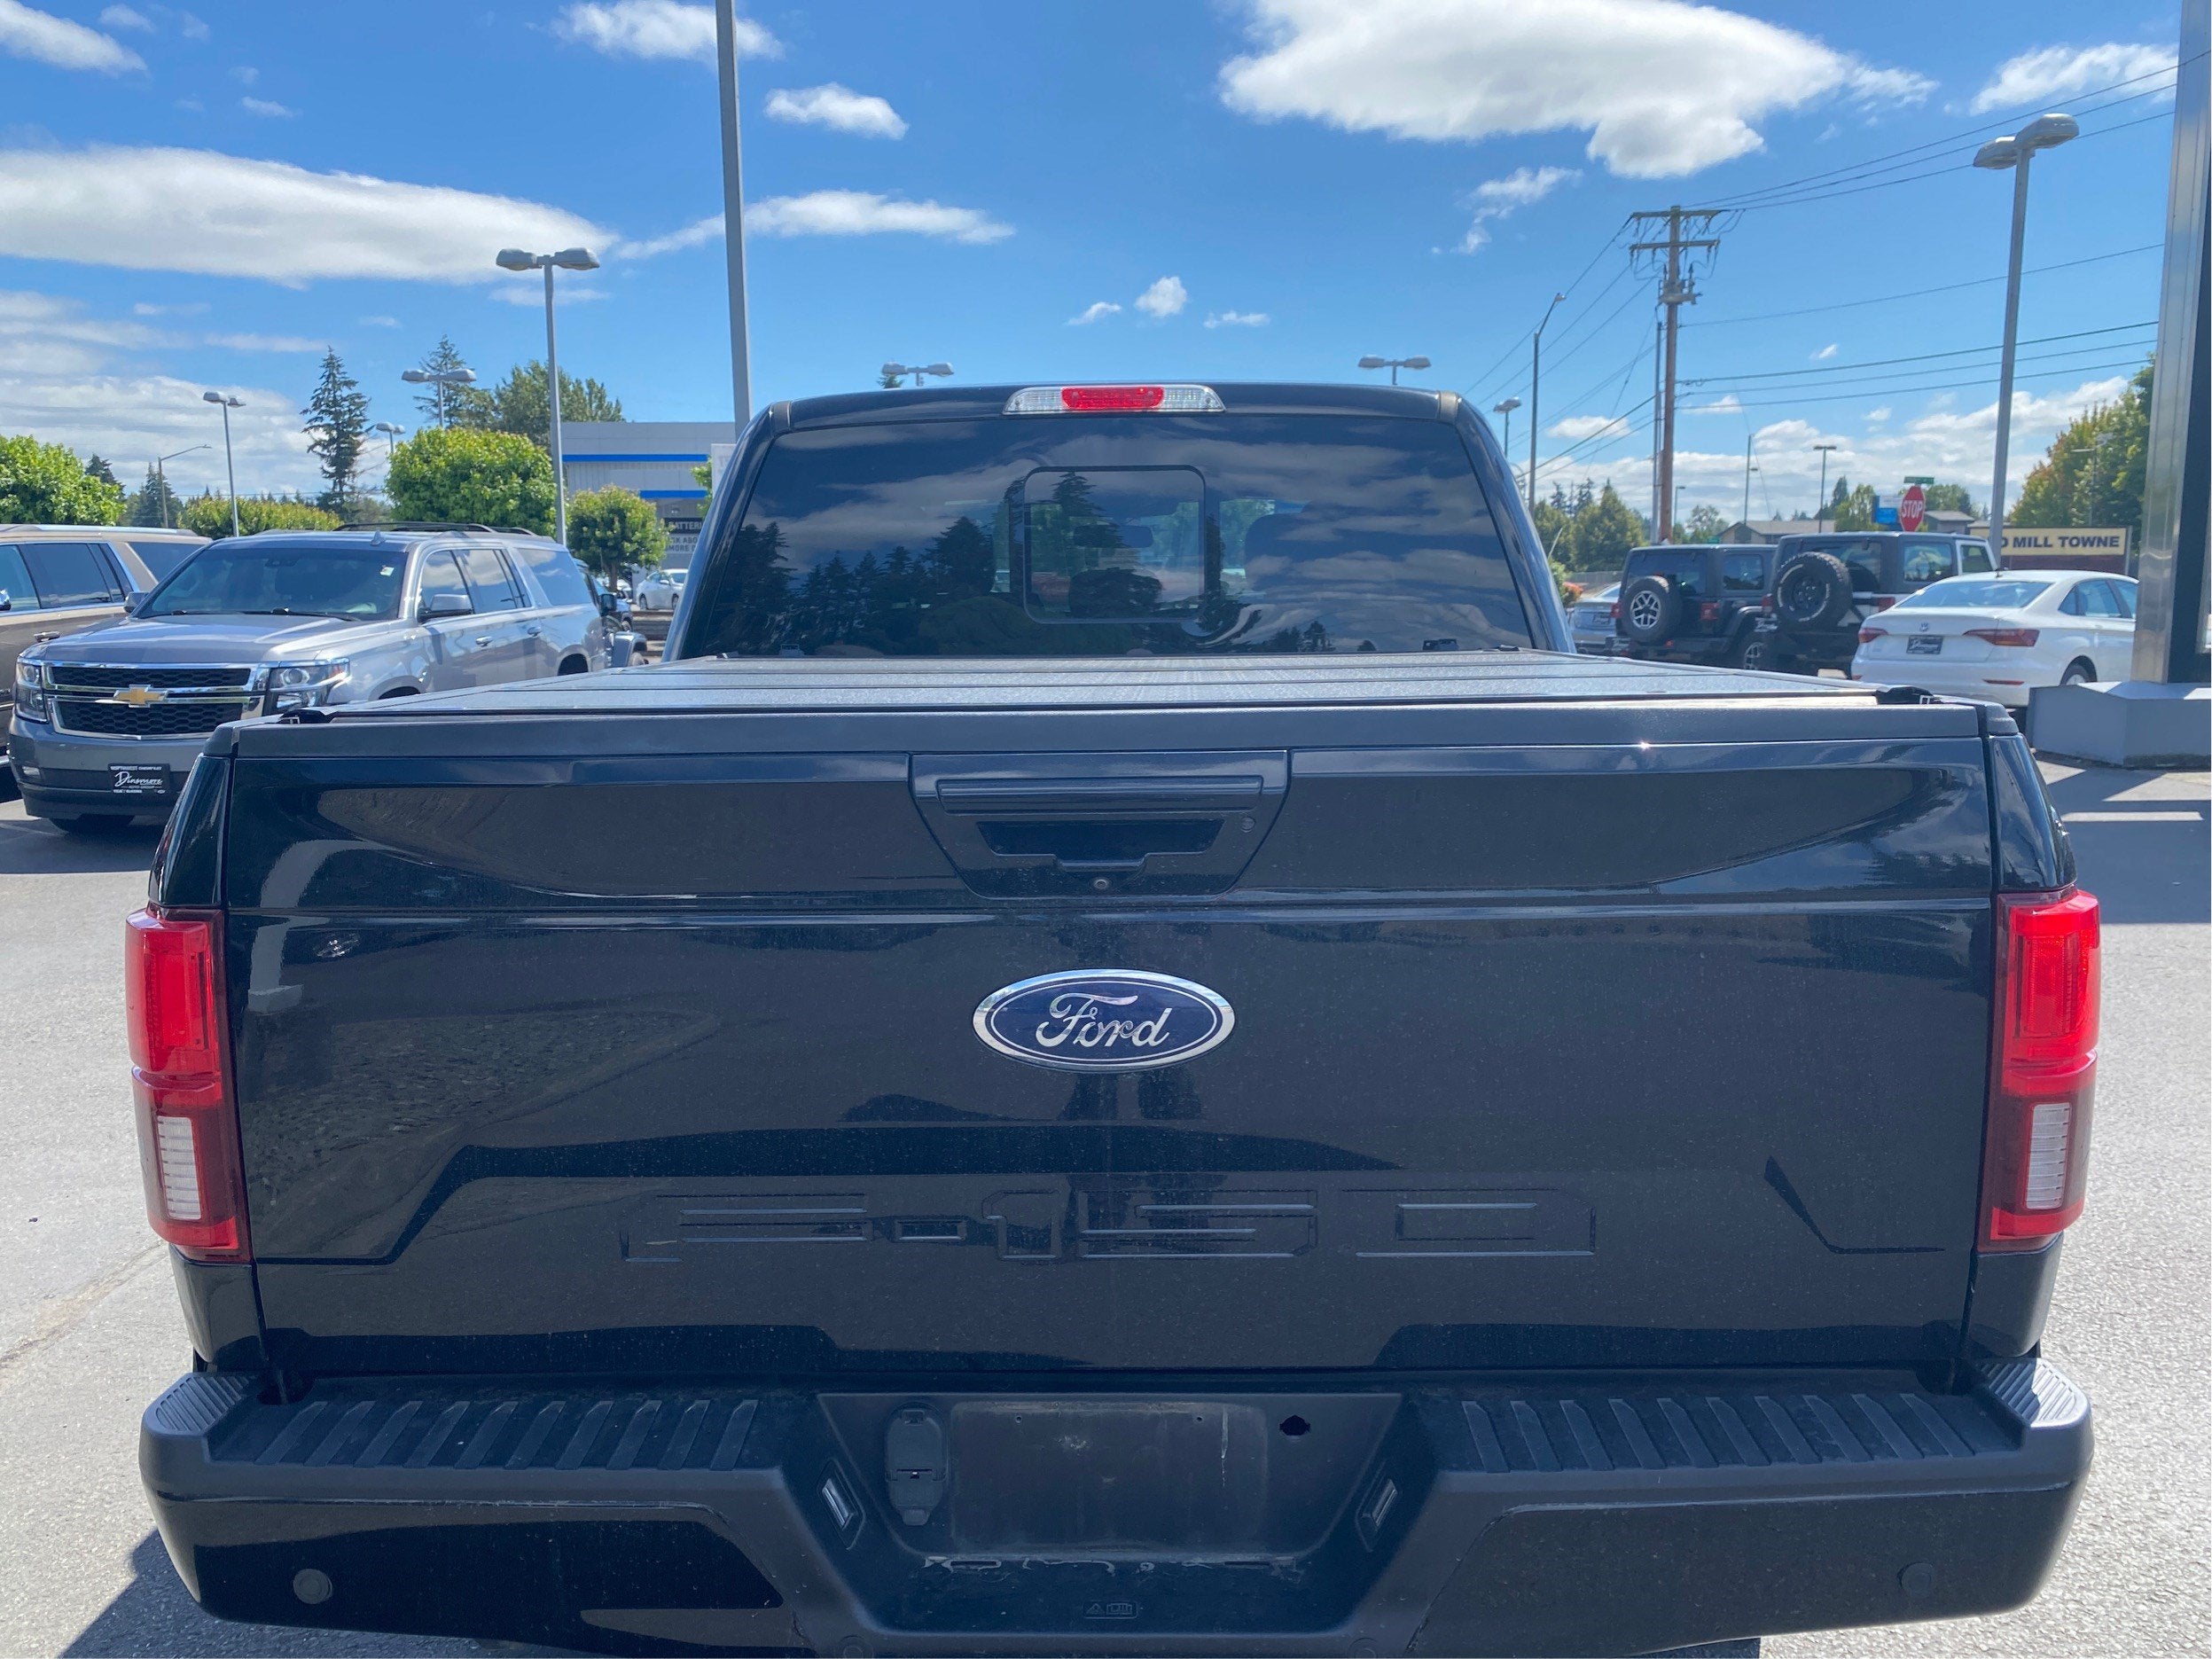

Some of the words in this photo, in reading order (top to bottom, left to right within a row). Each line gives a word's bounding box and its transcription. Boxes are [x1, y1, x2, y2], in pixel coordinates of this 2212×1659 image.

[1902, 500, 1923, 519] STOP
[2013, 536, 2053, 548] MILL
[2058, 536, 2120, 548] TOWNE
[1036, 992, 1172, 1047] Ford
[621, 1188, 1597, 1263] F-150
